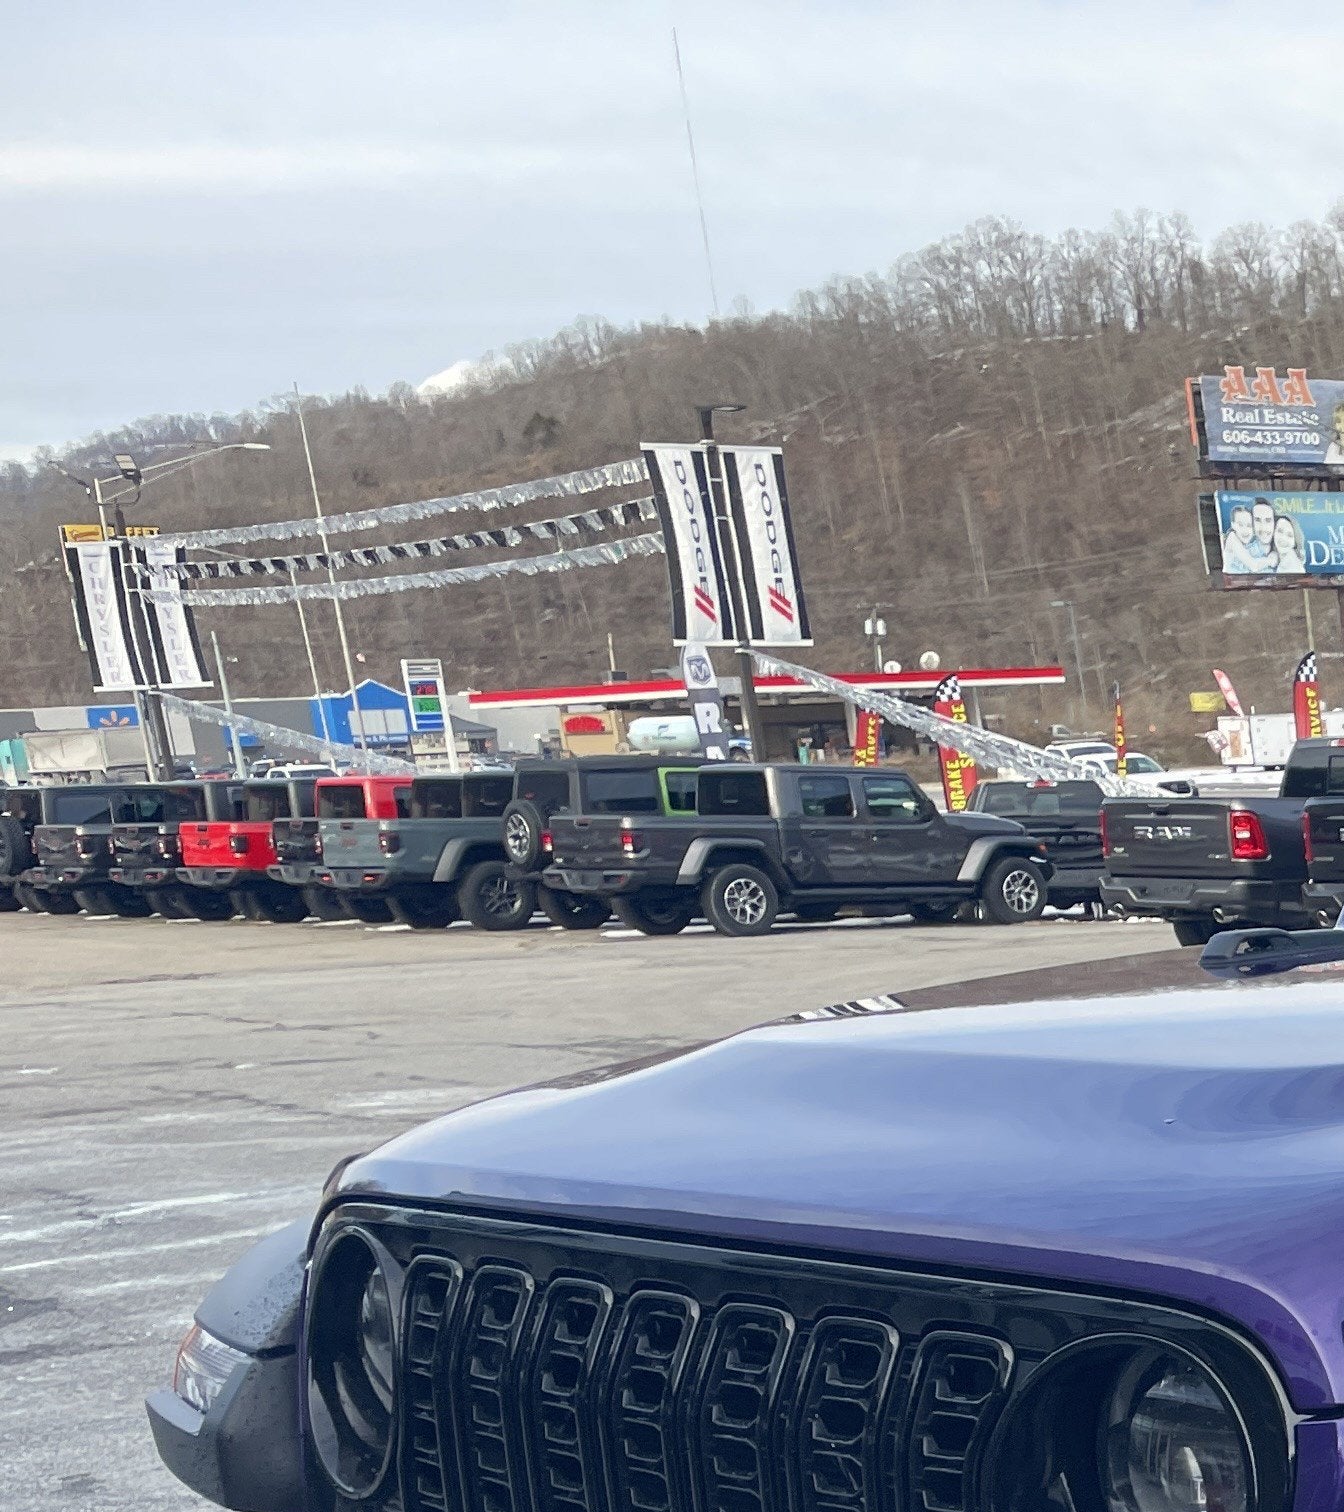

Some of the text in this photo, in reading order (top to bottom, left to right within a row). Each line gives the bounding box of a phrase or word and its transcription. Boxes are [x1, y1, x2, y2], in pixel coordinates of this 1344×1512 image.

[1220, 365, 1317, 407] AAA
[1221, 407, 1261, 424] Real
[1222, 429, 1321, 446] 606-433-9700
[674, 461, 710, 601] DODGE
[754, 464, 786, 601] DODGE
[88, 560, 125, 685] CHRYSLER
[945, 760, 967, 810] BRAKE
